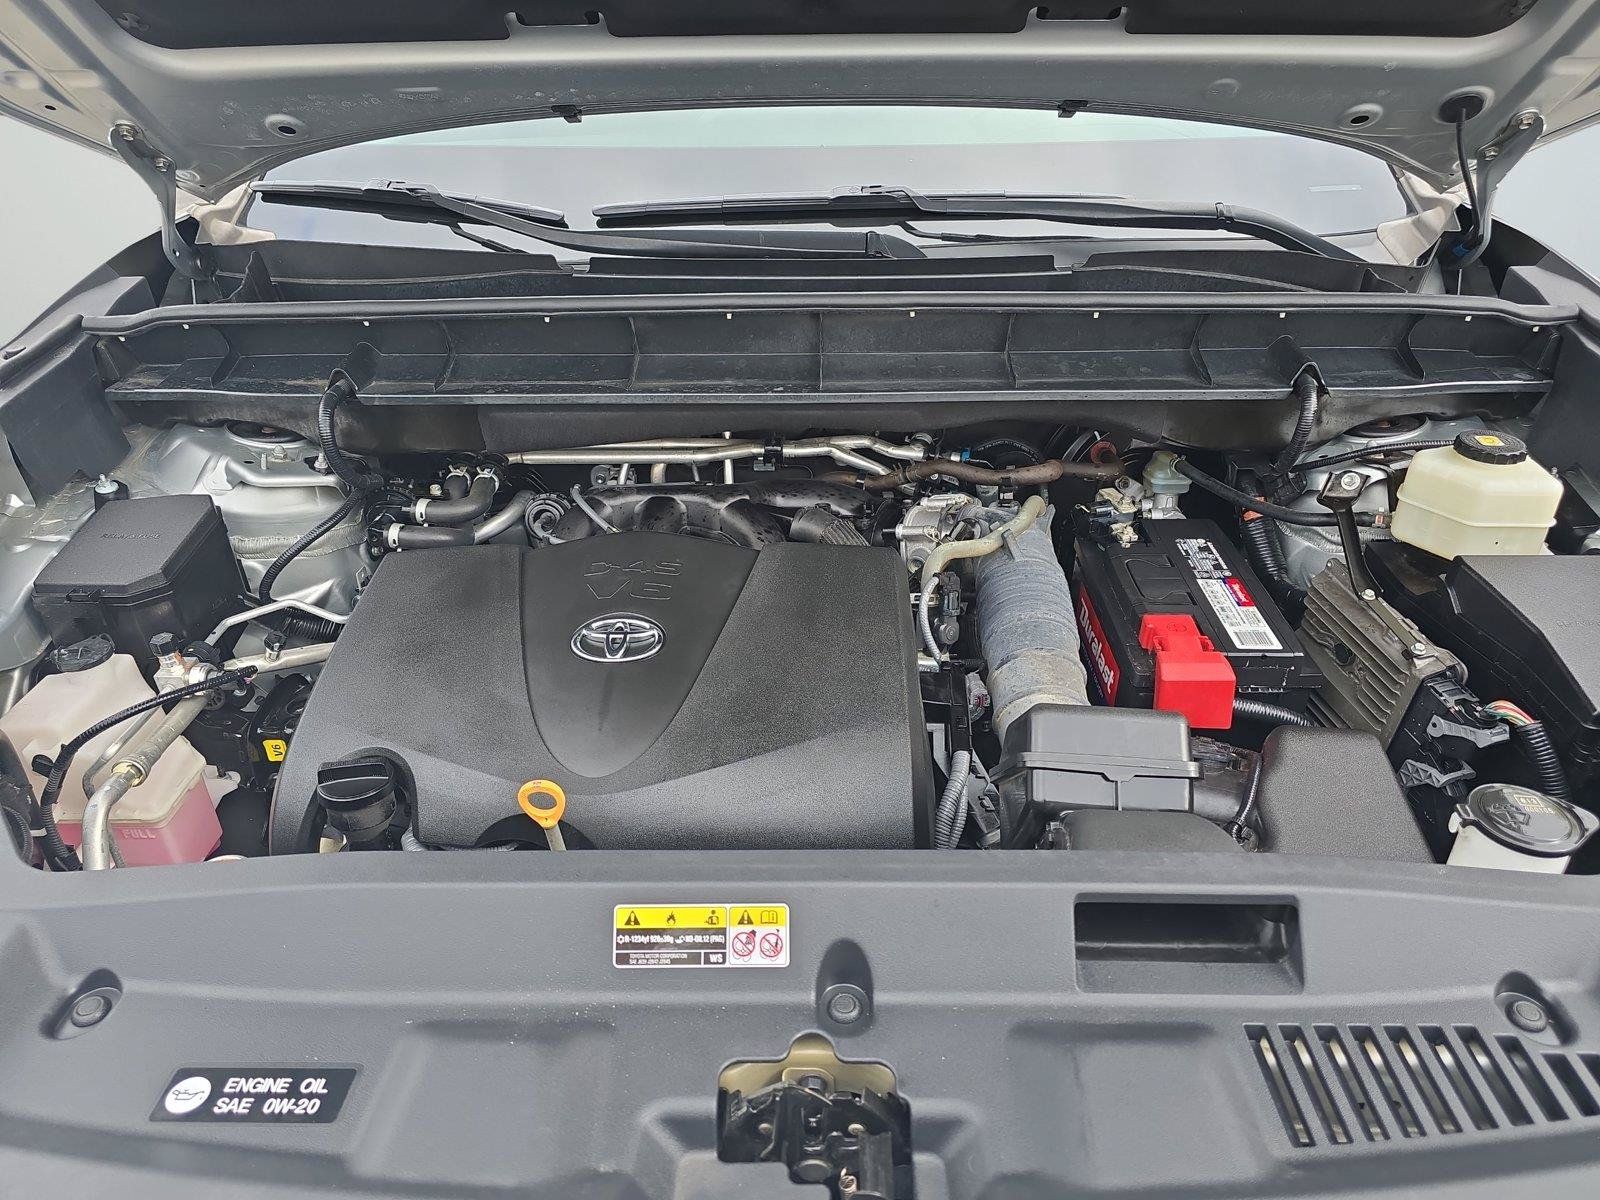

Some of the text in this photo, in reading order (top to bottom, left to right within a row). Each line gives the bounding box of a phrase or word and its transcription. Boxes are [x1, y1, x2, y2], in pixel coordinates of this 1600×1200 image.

[1080, 598, 1114, 694] Duralast
[271, 744, 283, 757] V6
[121, 829, 156, 839] FULL
[709, 953, 723, 963] WS
[223, 1077, 329, 1093] ENGINE OIL
[213, 1097, 321, 1115] SAE 0W-20
